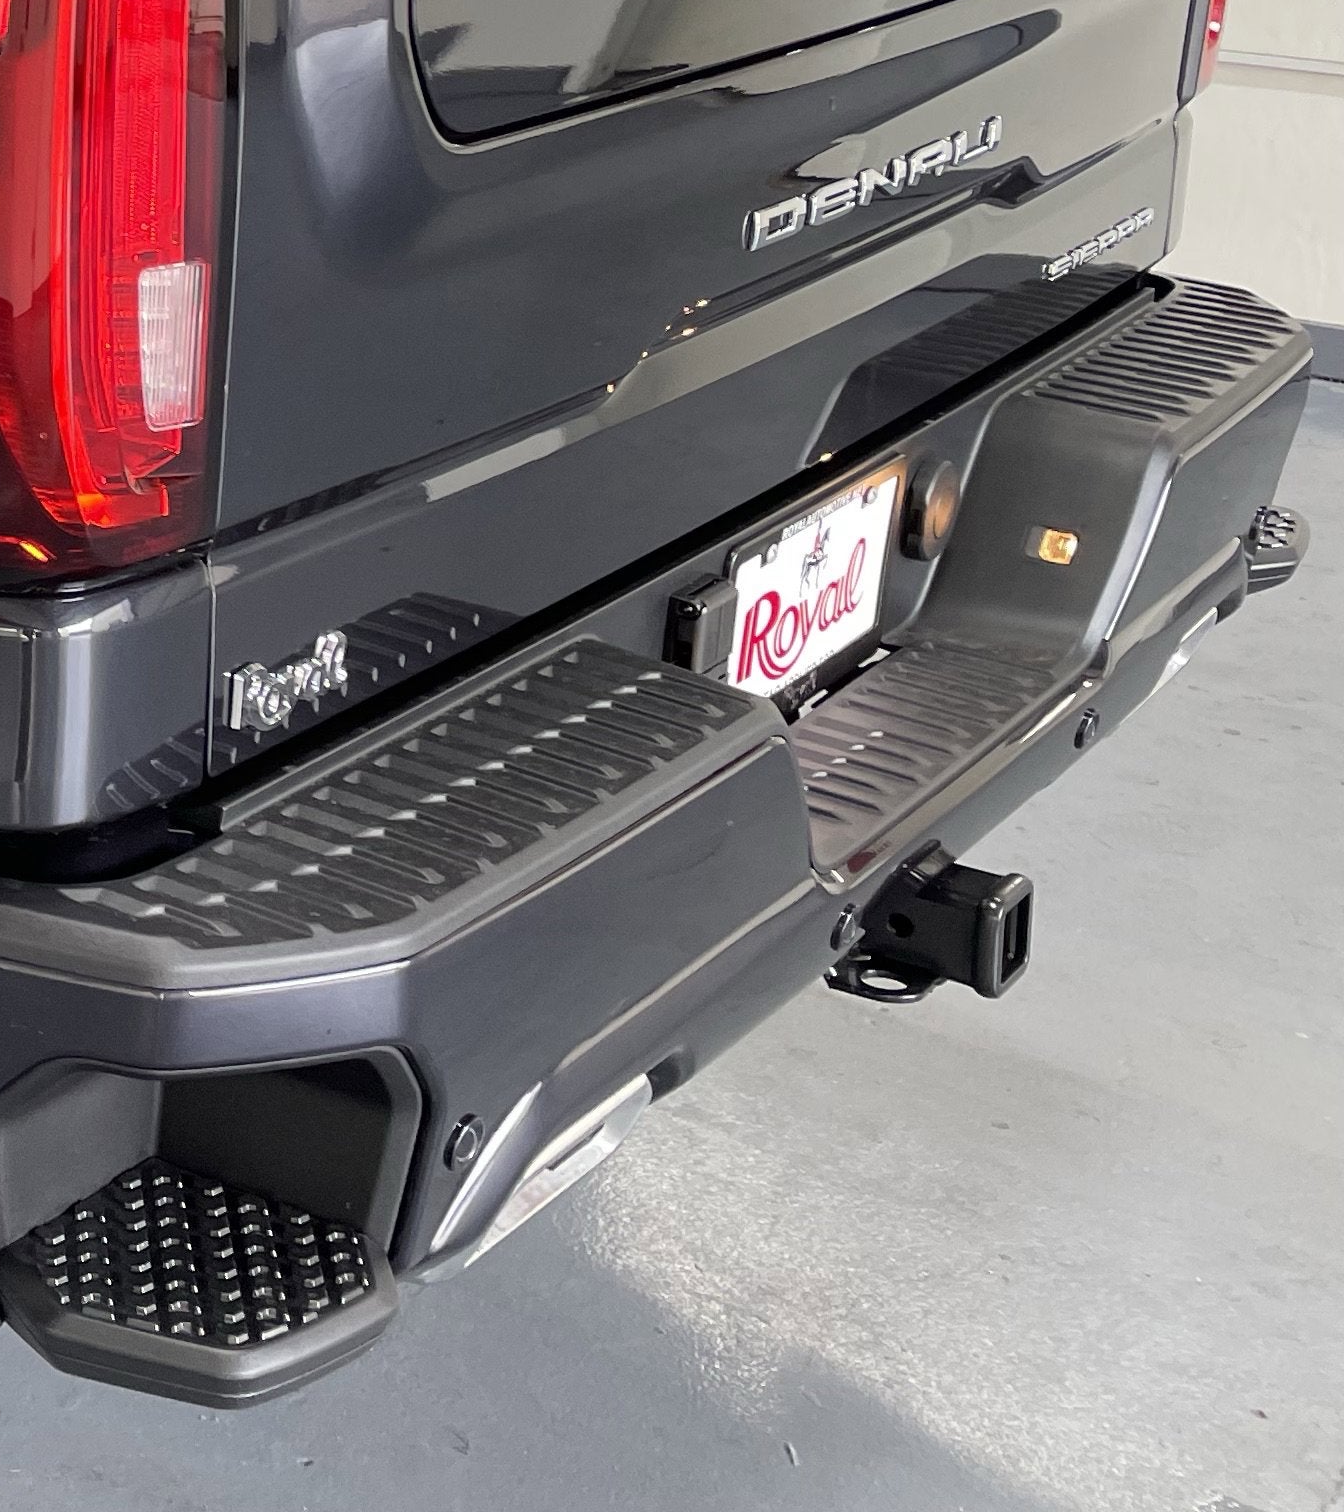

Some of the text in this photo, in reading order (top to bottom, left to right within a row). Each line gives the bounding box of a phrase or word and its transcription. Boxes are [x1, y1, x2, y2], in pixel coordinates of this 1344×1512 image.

[742, 115, 1003, 252] DENALI
[1041, 206, 1155, 282] SIERRA
[735, 536, 868, 684] Royal
